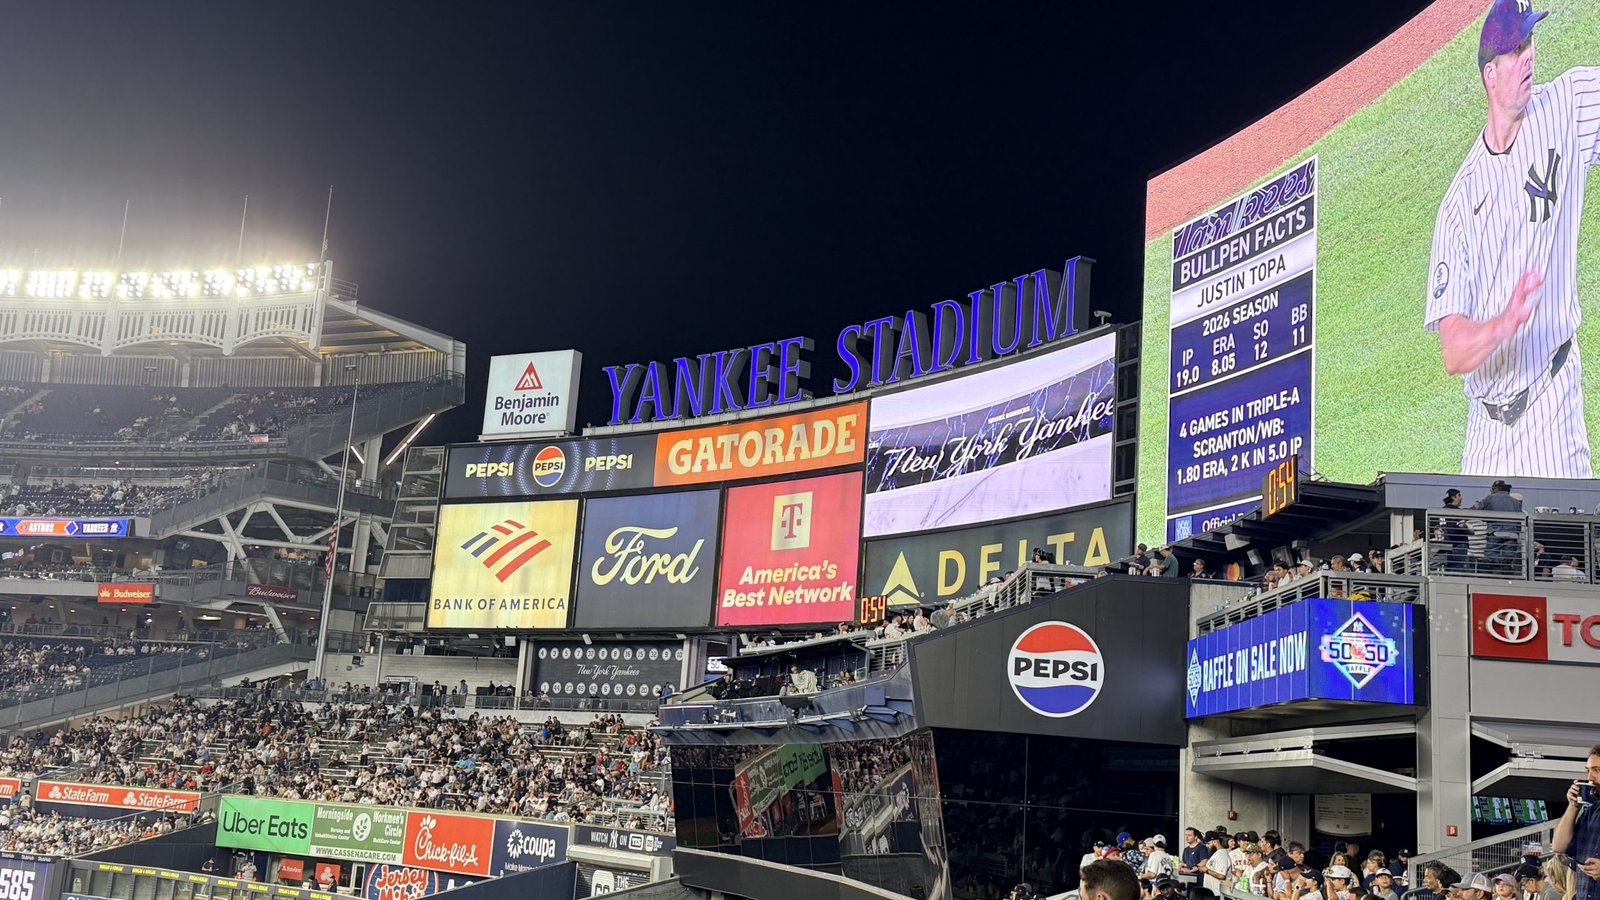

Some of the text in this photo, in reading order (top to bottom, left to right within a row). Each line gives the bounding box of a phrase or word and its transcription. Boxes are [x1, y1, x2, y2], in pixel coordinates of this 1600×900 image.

[1180, 205, 1306, 285] BULLPEN FACTS
[1197, 254, 1286, 308] JUSTIN TOPA
[1202, 291, 1279, 336] 2026 SEASON
[602, 255, 1082, 426] YANKEE STADIUM
[1183, 304, 1307, 366] IP ERA SO BB
[1177, 325, 1305, 388] 19.0 8.05 12 11
[494, 393, 560, 412] Benjamin
[1179, 387, 1300, 438] 4 GAMES IN TRIPLE-A
[500, 412, 546, 426] Moore
[668, 413, 857, 475] GATORADE
[884, 446, 944, 477] New
[947, 422, 1014, 478] York
[1193, 418, 1285, 458] SCRANTON/WB:
[465, 461, 514, 478] PEPSI
[534, 460, 564, 473] PEPSI
[584, 453, 633, 472] PEPSI
[1177, 436, 1302, 485] 1.80 ERA, 2 K IN 5.0 IP
[1268, 457, 1295, 515] 0:54
[83, 523, 108, 533] YANKEES
[592, 526, 704, 585] Ford
[738, 560, 838, 585] America's
[113, 589, 152, 599] Budweiser
[248, 586, 297, 600] Budweiser
[434, 597, 565, 610] BANK OF AMERICA
[722, 581, 853, 608] Best Network
[860, 595, 887, 624] 0:54
[577, 663, 640, 680] New York Yankees
[1014, 657, 1097, 681] PEPSI
[1203, 630, 1307, 692] RAFFLE ON SALE NOW
[222, 811, 308, 839] Uber Eats
[317, 807, 354, 822] Morningside
[373, 811, 404, 825] Workmen's
[384, 824, 402, 837] Circle
[591, 831, 608, 844] WATCH
[620, 834, 627, 846] ON
[316, 847, 397, 861] WWW.CASSENACARE.COM
[415, 822, 478, 867] Chick-fil-A
[523, 835, 556, 862] coupa
[0, 868, 35, 900] 585
[375, 865, 428, 891] Jersey
